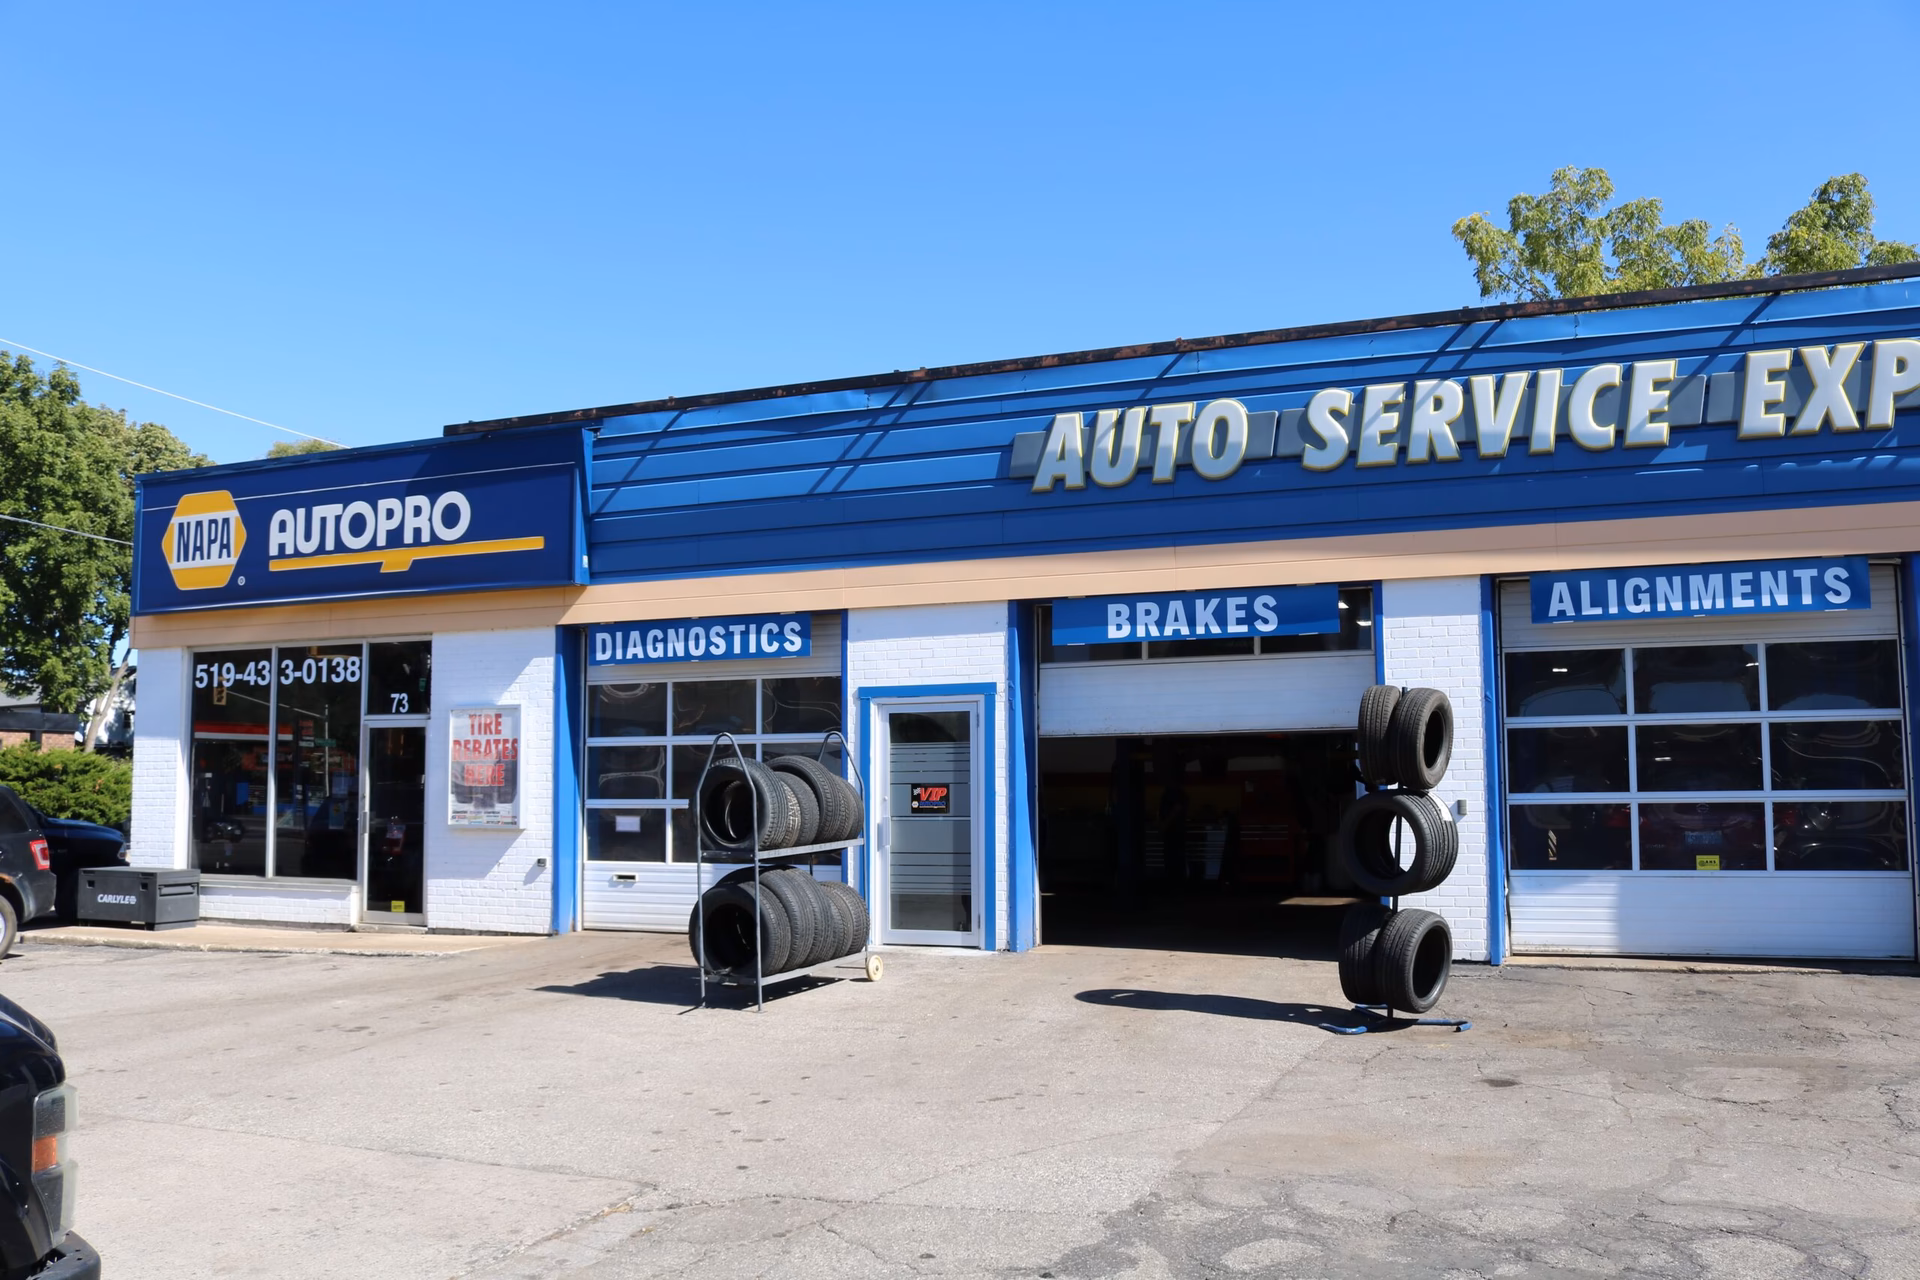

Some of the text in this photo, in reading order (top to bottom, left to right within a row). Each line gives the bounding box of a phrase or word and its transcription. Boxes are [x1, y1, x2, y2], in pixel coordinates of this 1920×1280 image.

[1031, 337, 1920, 493] AUTO SERVICE EXP
[268, 490, 472, 556] AUTOPRO
[176, 517, 232, 563] NAPA
[1548, 566, 1851, 617] ALIGNMENTS
[1107, 594, 1279, 639] BRAKES
[595, 621, 802, 661] DIAGNOSTICS
[390, 692, 409, 714] 73
[468, 713, 503, 736] TIRE
[452, 738, 519, 762] REBATES
[463, 763, 505, 787] HERE
[920, 787, 948, 801] VIP
[97, 893, 130, 905] CARLYLE
